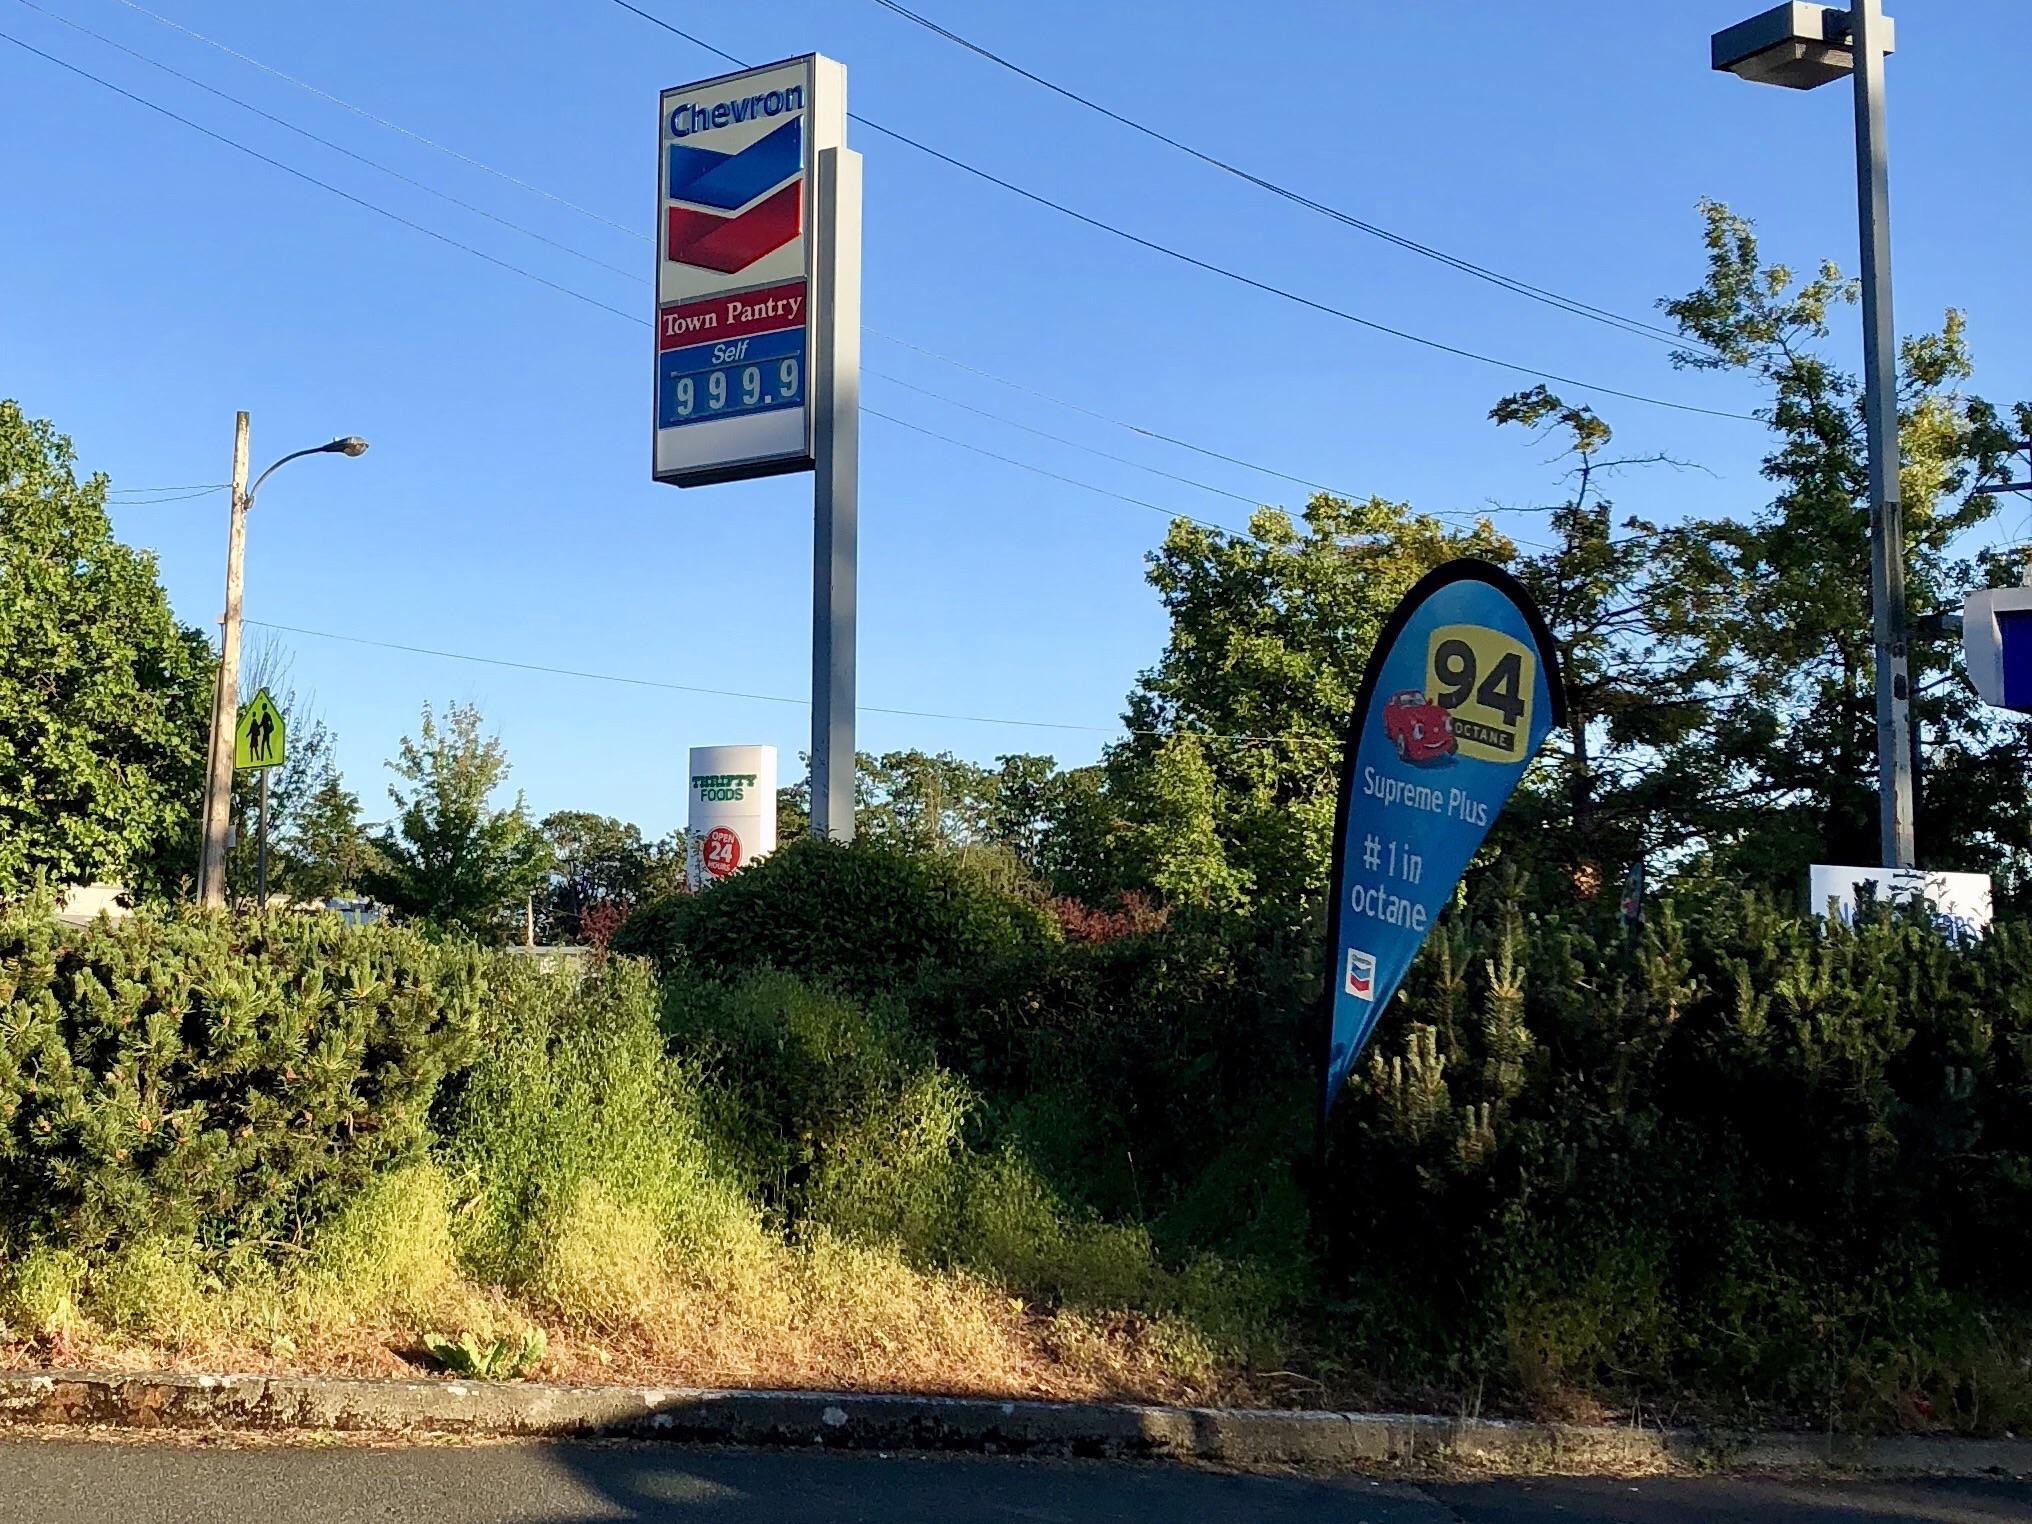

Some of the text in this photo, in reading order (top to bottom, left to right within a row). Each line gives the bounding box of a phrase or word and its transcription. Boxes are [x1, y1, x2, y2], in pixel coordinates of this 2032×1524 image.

[669, 84, 804, 138] Chevron
[663, 295, 802, 336] Town Pantry
[711, 340, 750, 364] Self
[1434, 639, 1525, 727] 94
[1454, 724, 1509, 746] OCTANE
[691, 774, 757, 788] THRIFTY
[700, 788, 744, 802] FOODS
[1363, 766, 1488, 827] Supreme Plus
[708, 840, 733, 863] 24
[711, 831, 735, 844] OPEN
[1401, 843, 1423, 884] in
[1351, 883, 1428, 931] octane
